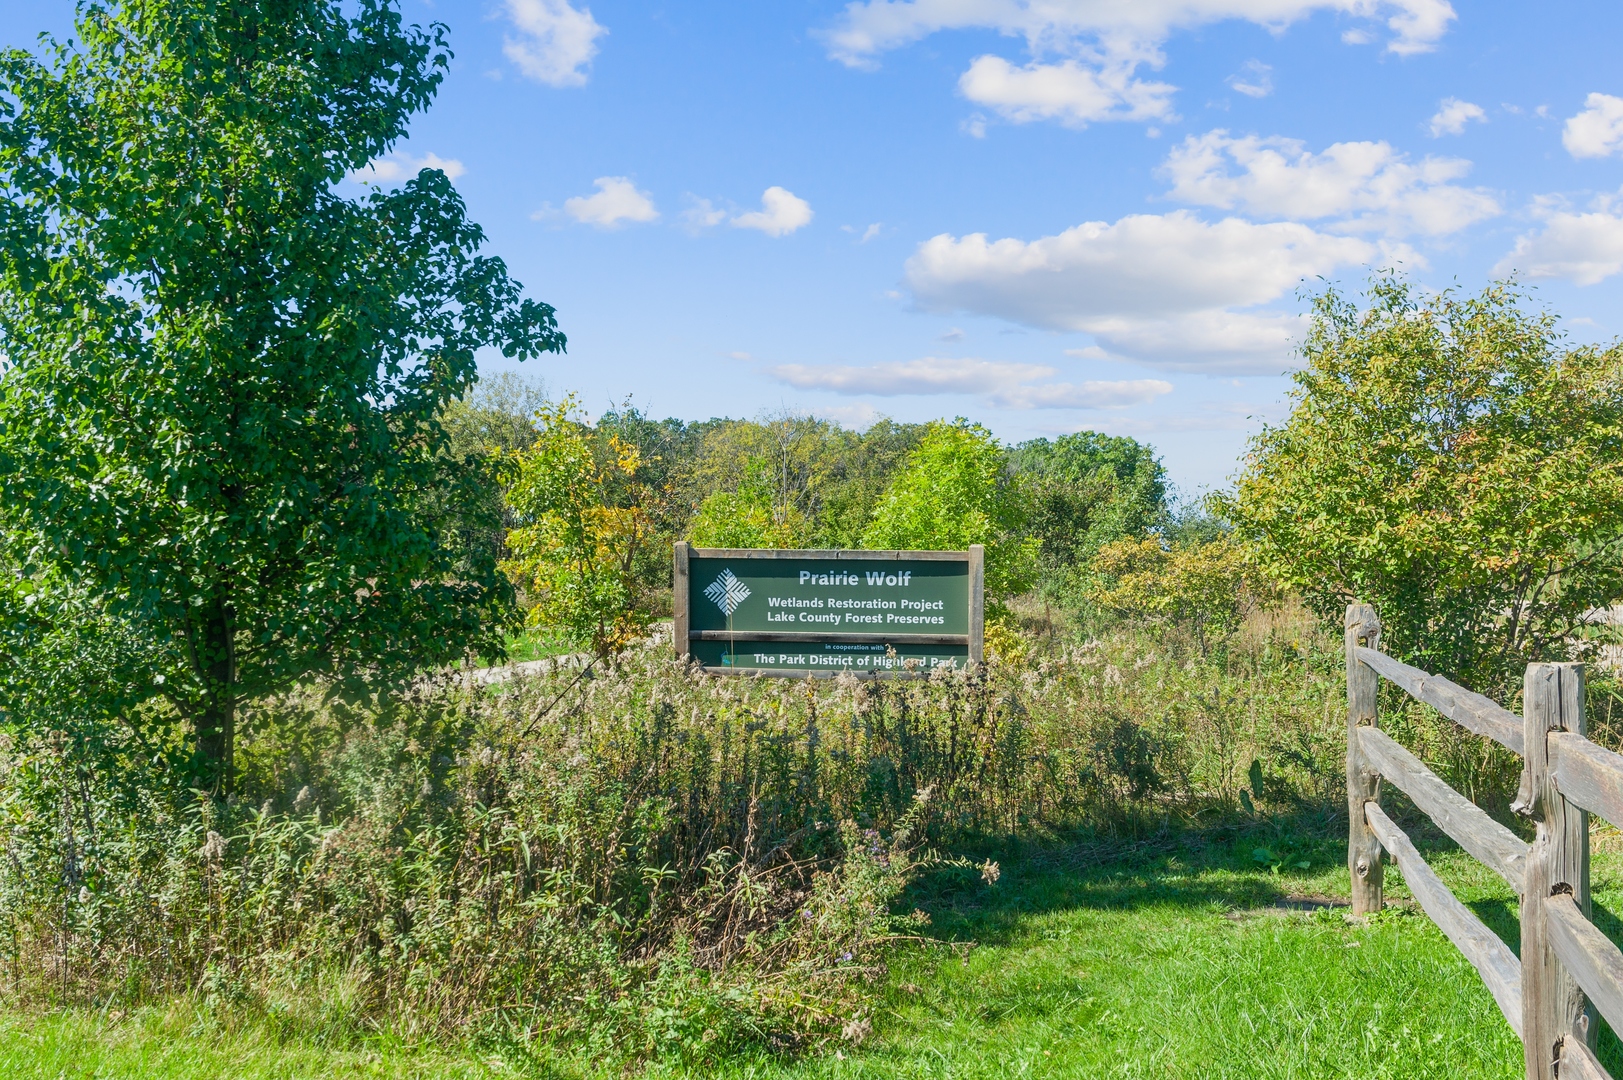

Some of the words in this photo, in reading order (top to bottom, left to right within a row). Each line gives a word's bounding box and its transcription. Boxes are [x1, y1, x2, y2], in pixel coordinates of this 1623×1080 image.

[799, 570, 859, 586] Prairie
[866, 570, 911, 587] Wolf
[768, 597, 824, 608] Wetlands
[827, 598, 897, 610] Restoration
[901, 599, 943, 612] Project
[767, 612, 795, 622] Lake
[799, 612, 841, 625] County
[845, 613, 883, 623] Forest
[886, 613, 944, 624] Preserves
[754, 653, 776, 664] The
[779, 654, 805, 665] Park
[809, 655, 853, 666] District
[856, 655, 870, 666] of
[874, 656, 926, 668] Highld
